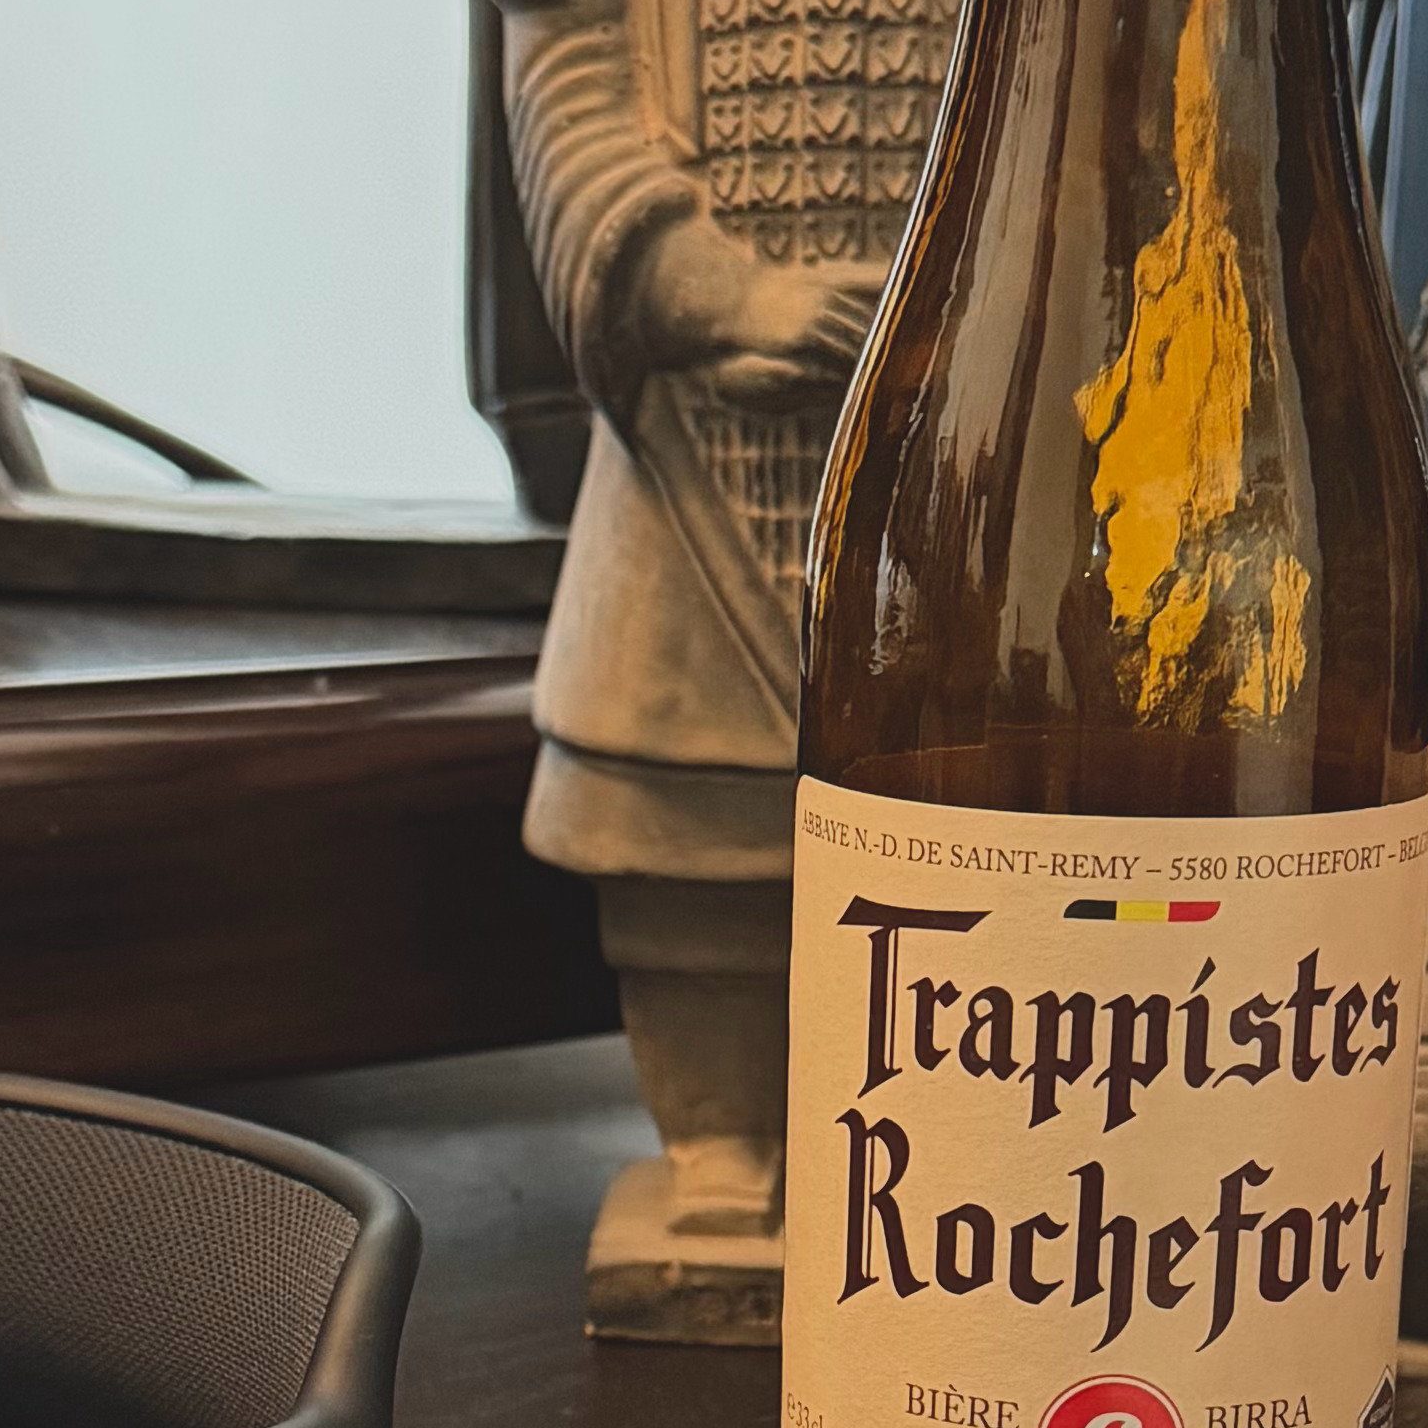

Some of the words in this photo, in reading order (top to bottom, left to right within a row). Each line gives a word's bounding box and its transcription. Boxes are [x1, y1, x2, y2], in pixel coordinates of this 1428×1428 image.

[801, 808, 850, 848] ABBAYE
[907, 838, 943, 866] DE
[950, 844, 1143, 882] SAINT-REMY
[1169, 856, 1228, 882] 5580
[1236, 844, 1386, 880] ROCHEFORT
[836, 895, 1401, 1133] Trappistes
[835, 1108, 1392, 1353] Rochefort
